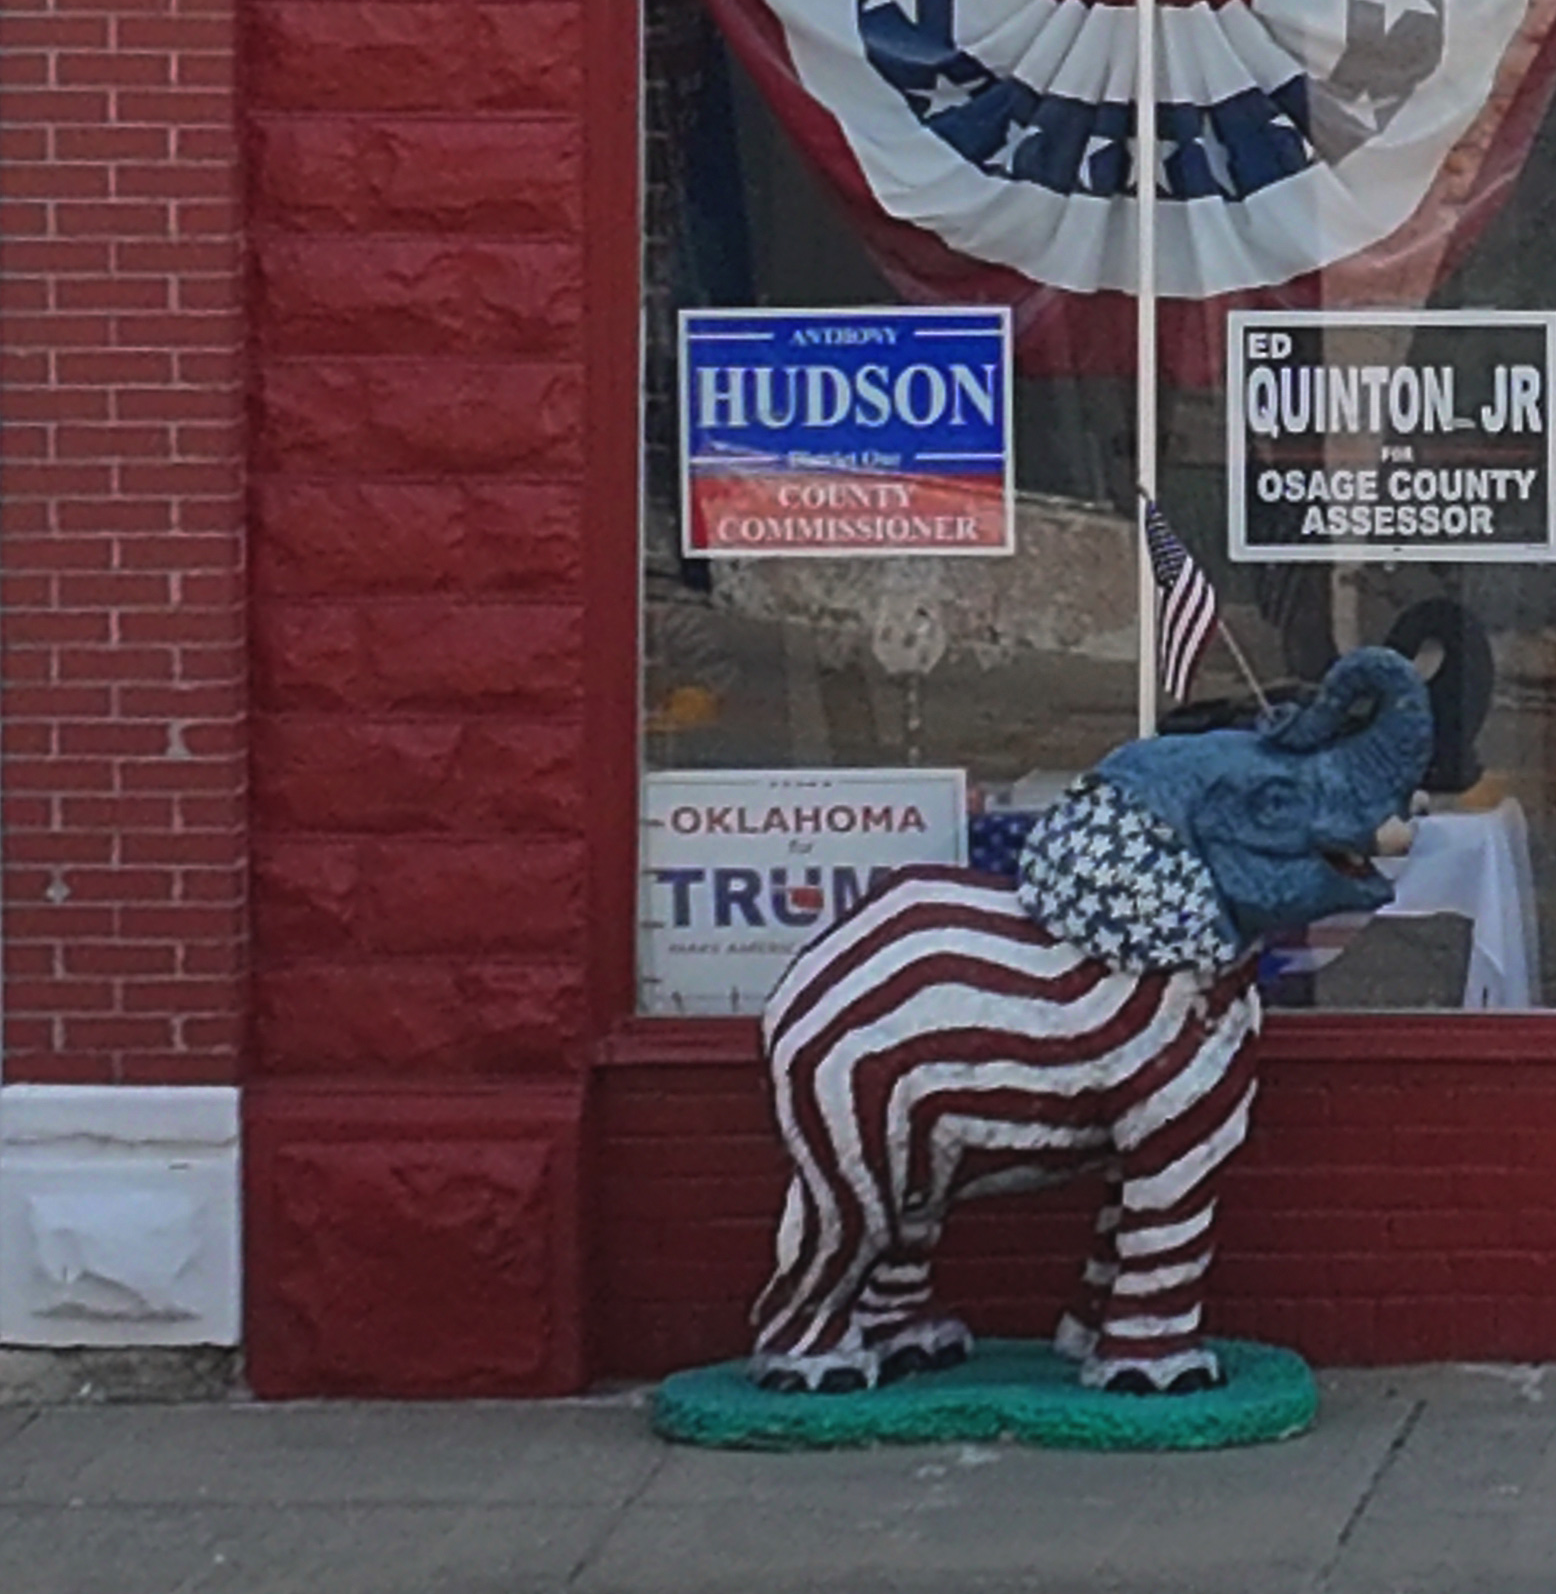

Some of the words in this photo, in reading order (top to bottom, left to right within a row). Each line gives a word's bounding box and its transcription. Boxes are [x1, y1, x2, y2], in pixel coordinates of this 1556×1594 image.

[790, 327, 898, 346] ANTHONY
[1249, 332, 1292, 358] ED
[698, 363, 997, 428] HUDSON
[1480, 363, 1543, 434] JR
[1381, 446, 1414, 462] FOR
[778, 481, 913, 508] COUNTY
[1257, 469, 1379, 502] OSAGE
[1388, 468, 1537, 502] COUNTY
[718, 515, 980, 543] COMMISSIONER
[1302, 505, 1495, 536] ASSESSOR
[671, 806, 927, 835] OKLAHOMA
[656, 865, 895, 930] TRUM
